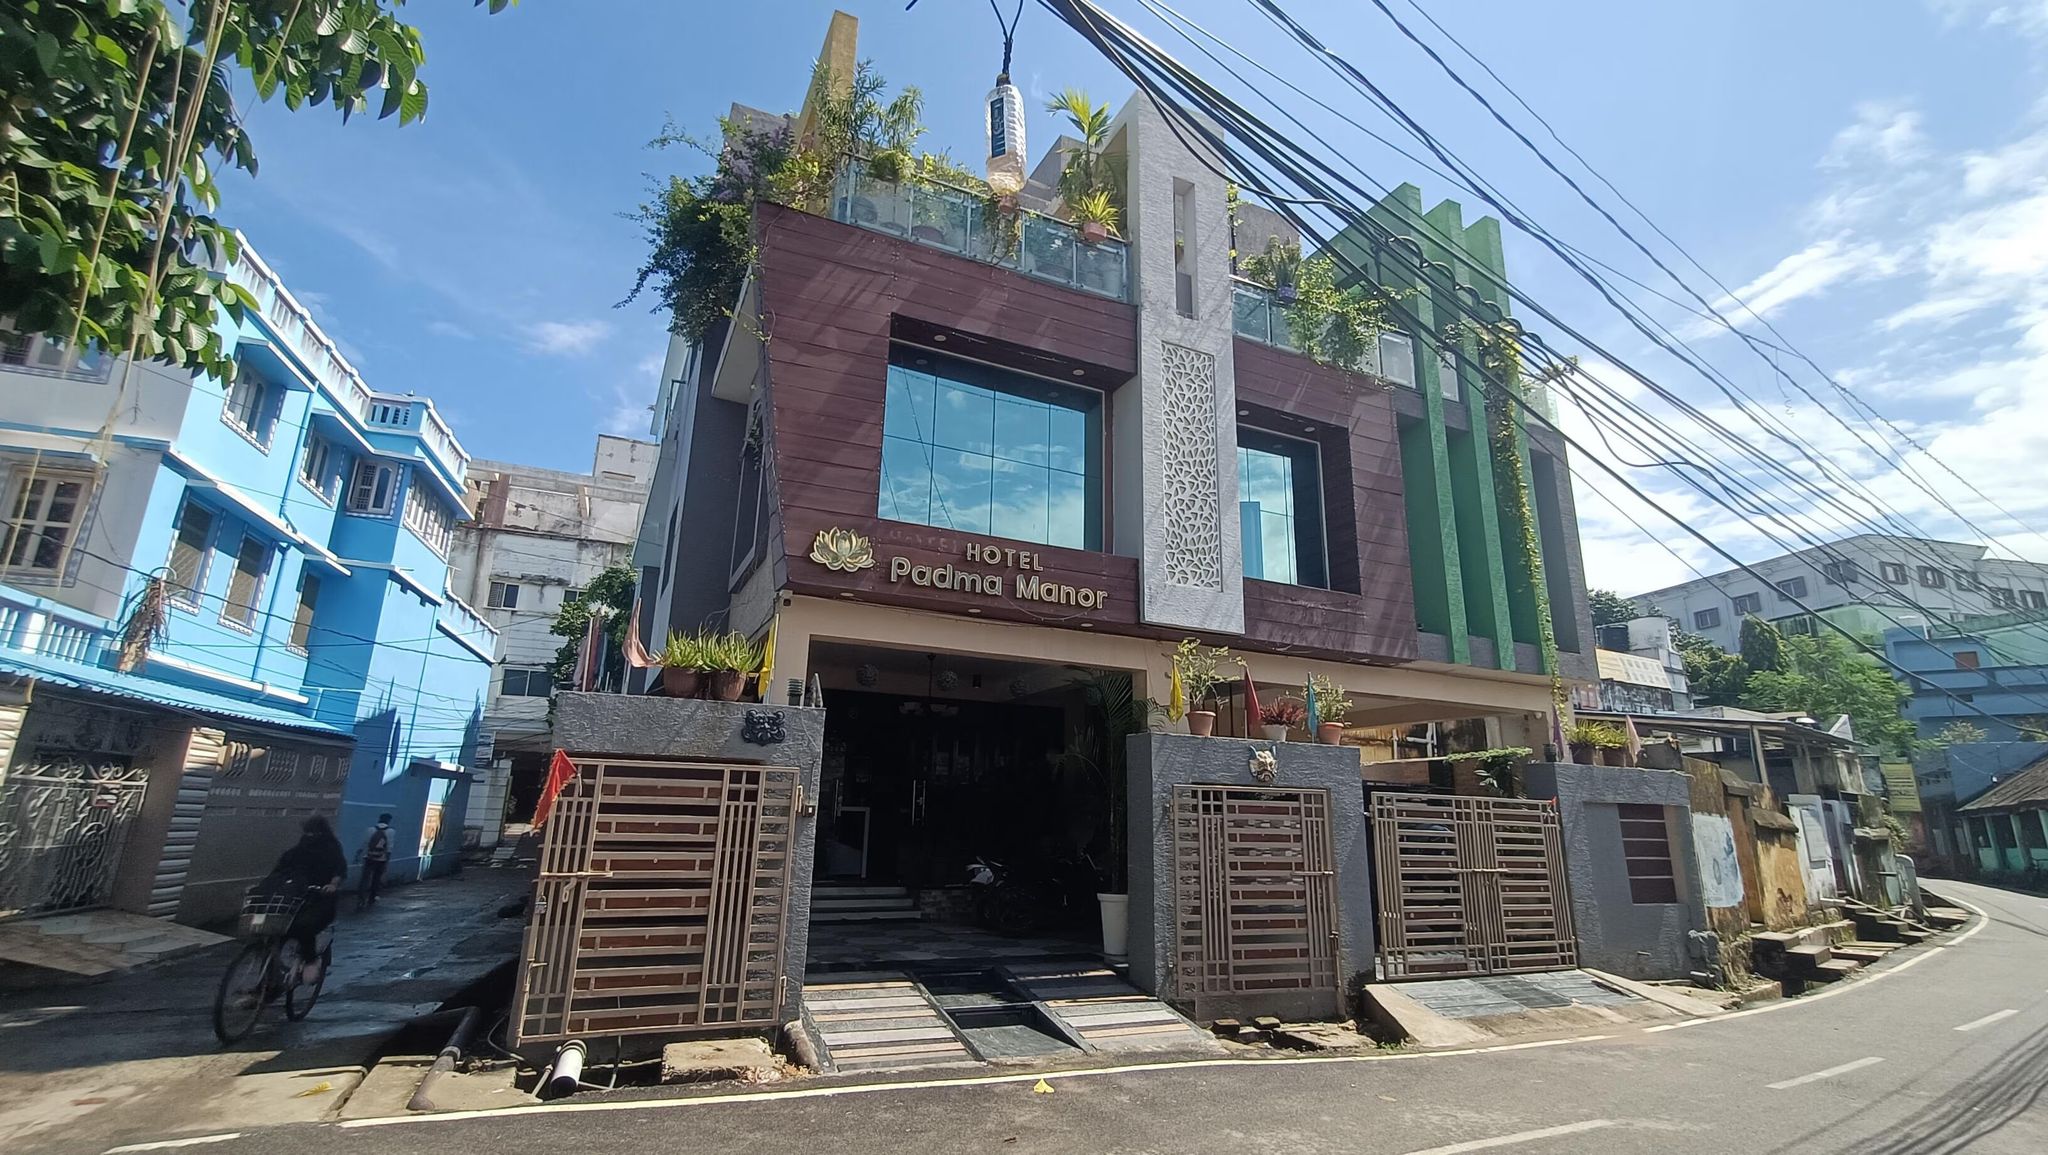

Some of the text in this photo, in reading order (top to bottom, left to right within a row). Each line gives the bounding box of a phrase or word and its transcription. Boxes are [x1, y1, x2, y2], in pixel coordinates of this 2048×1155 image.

[966, 542, 1044, 572] HOTEL
[890, 556, 1108, 609] Padma Manor
